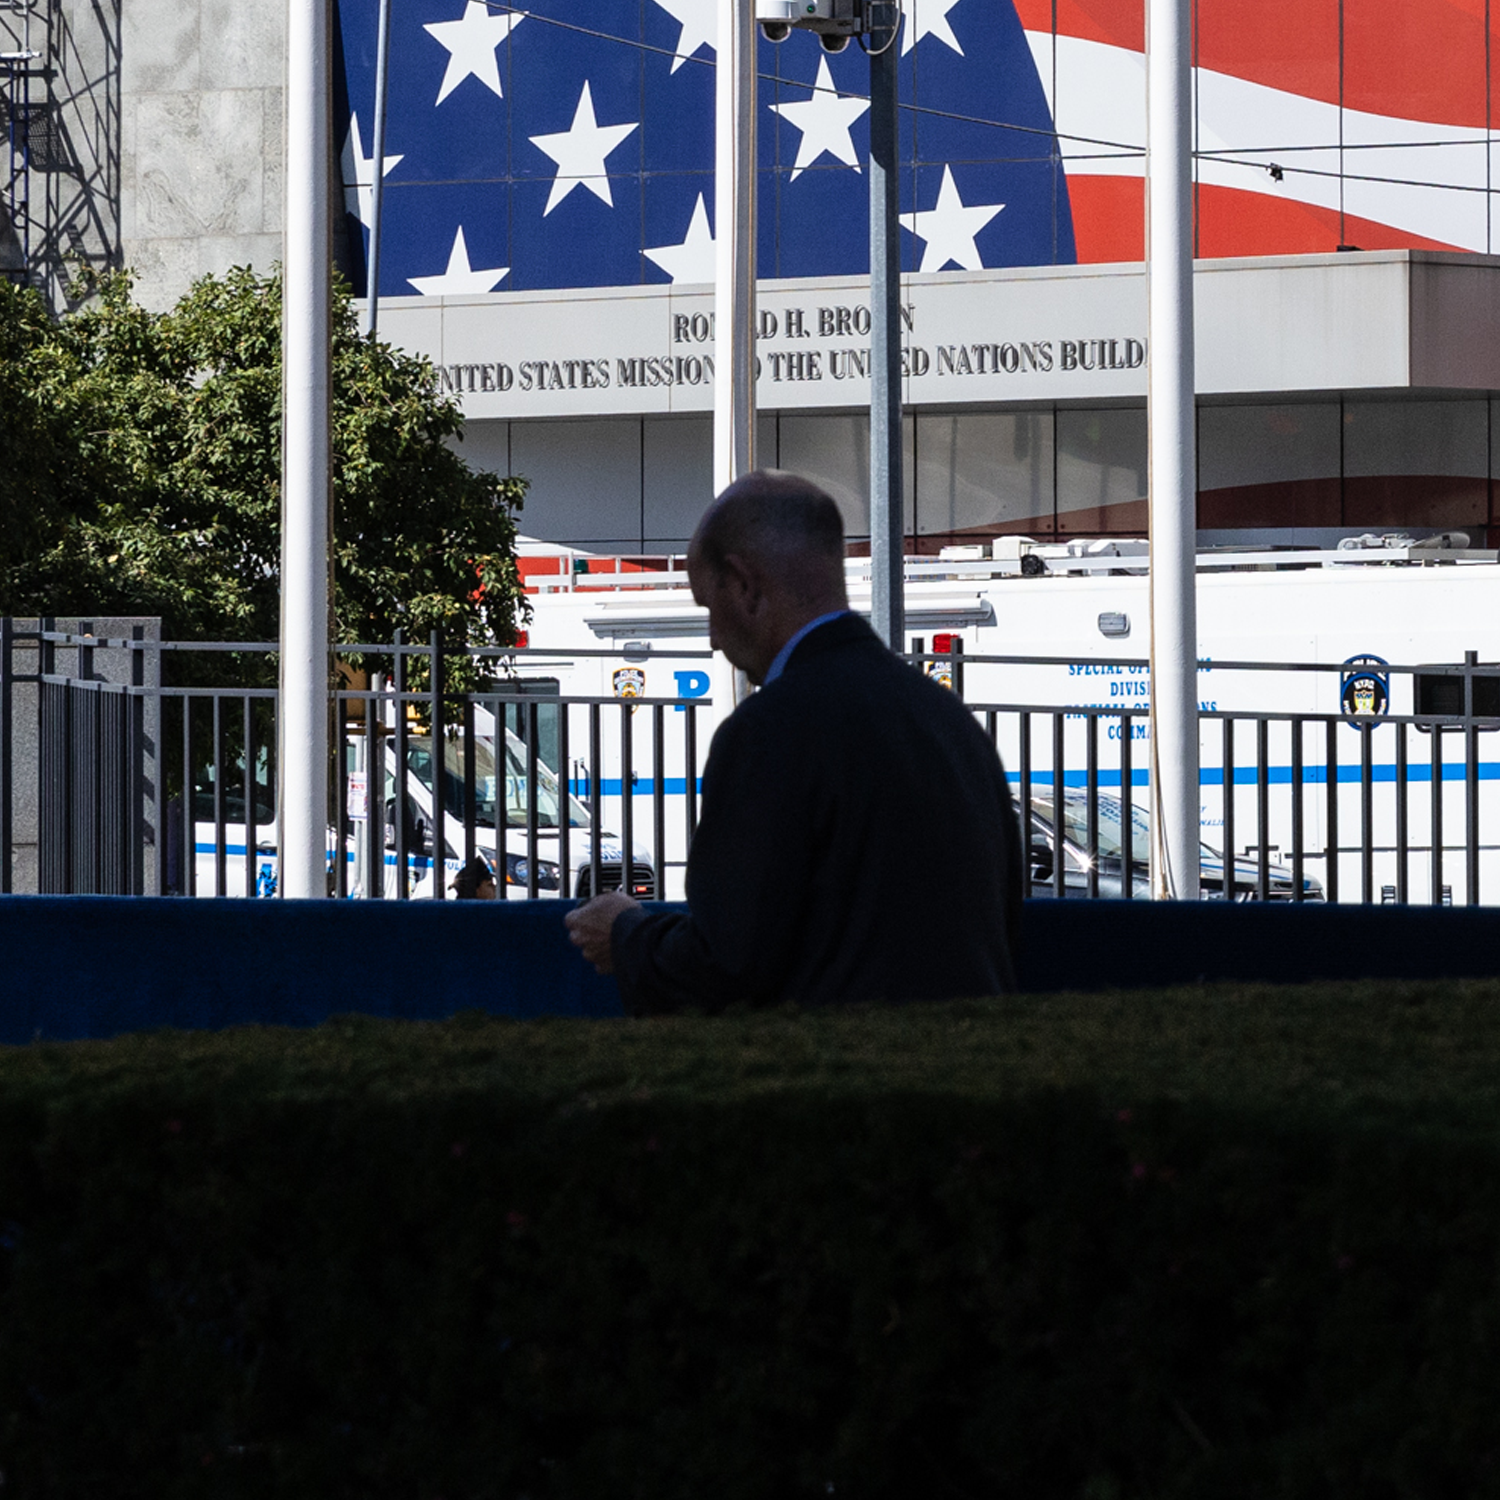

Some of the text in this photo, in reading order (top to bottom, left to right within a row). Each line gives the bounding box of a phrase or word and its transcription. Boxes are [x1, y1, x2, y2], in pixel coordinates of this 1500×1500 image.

[785, 307, 811, 340] H.
[817, 302, 916, 338] BRON
[434, 361, 514, 395] NITED
[518, 357, 611, 393] STATES
[767, 351, 822, 383] THE
[936, 341, 1053, 377] NATIONS
[1059, 337, 1149, 371] BUILD
[1110, 681, 1150, 697] DIVIS
